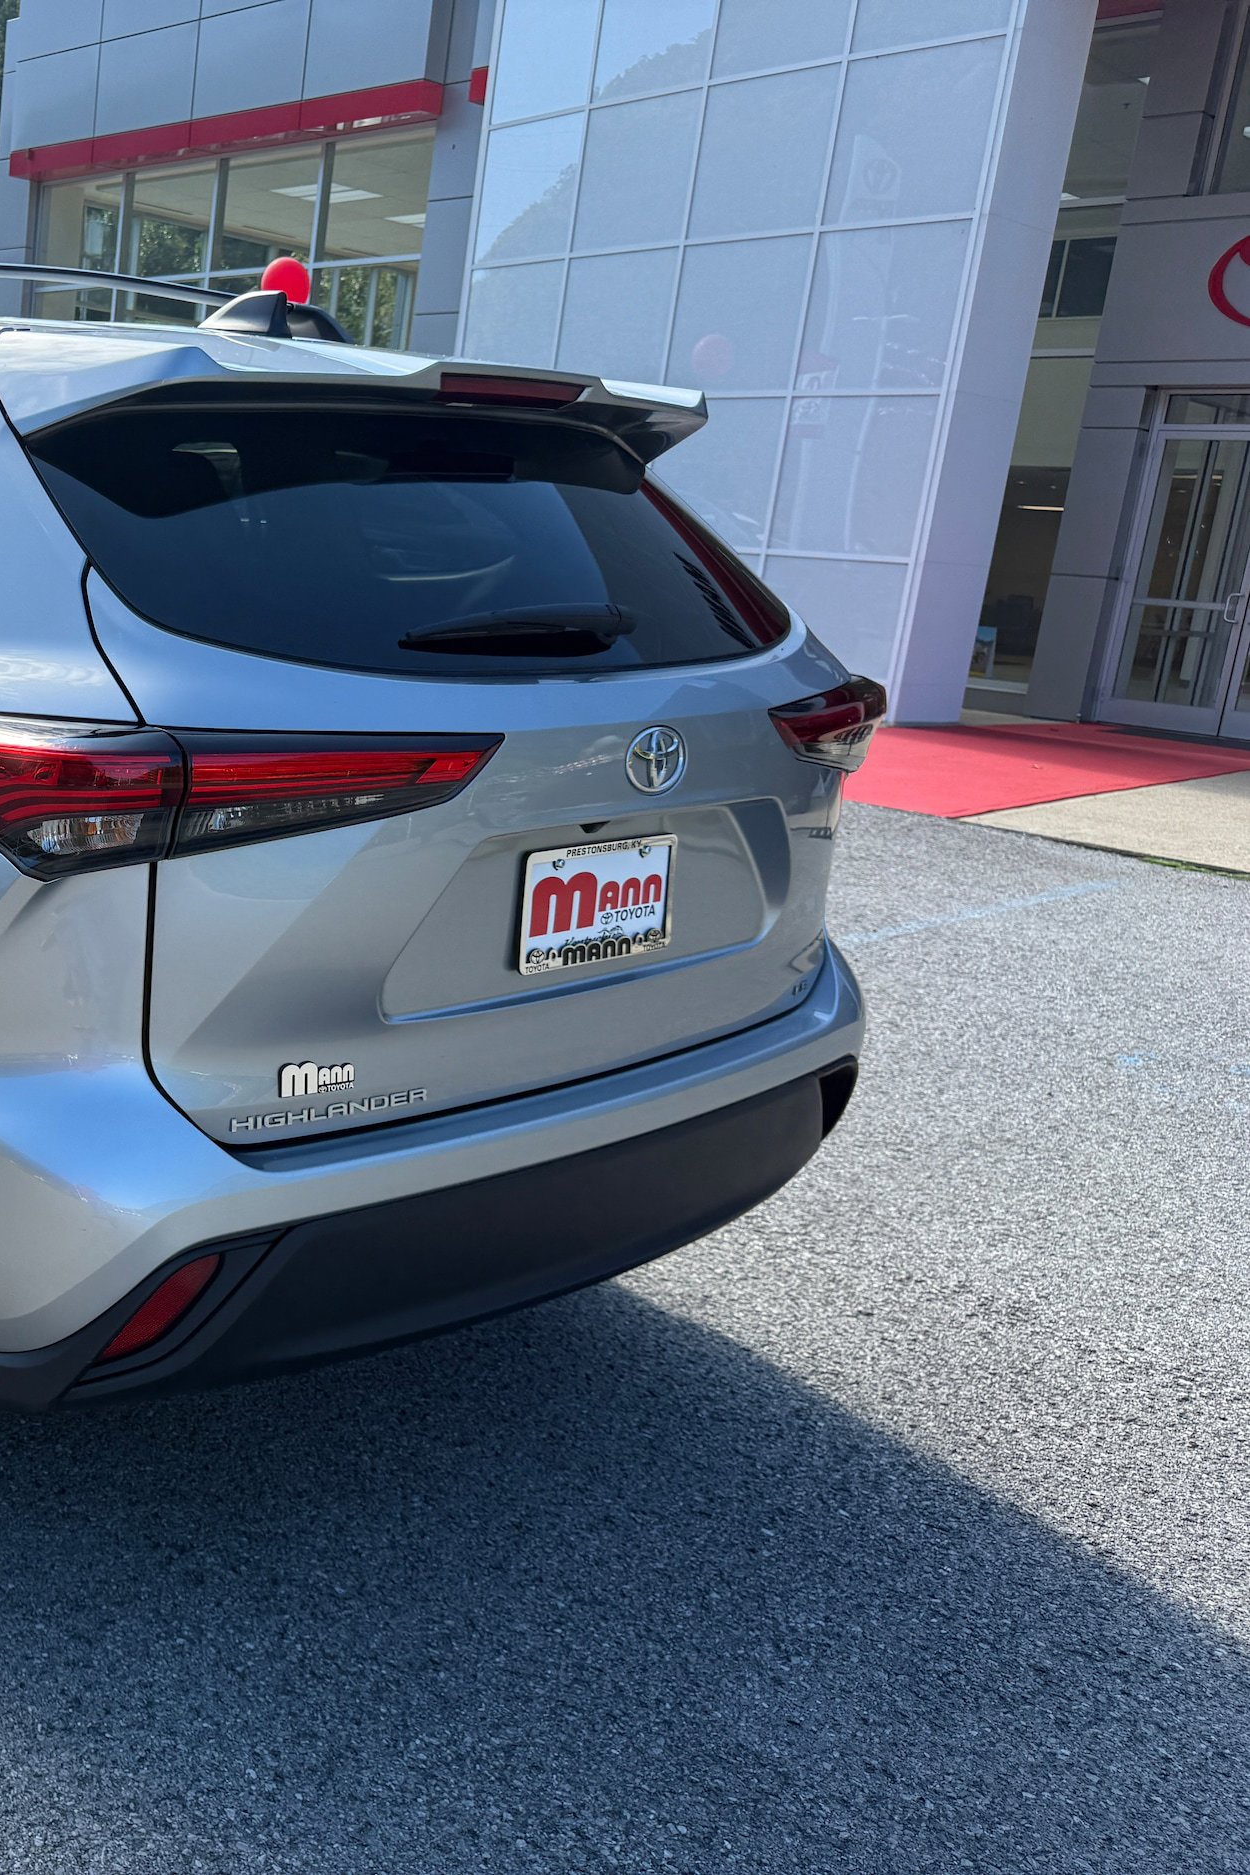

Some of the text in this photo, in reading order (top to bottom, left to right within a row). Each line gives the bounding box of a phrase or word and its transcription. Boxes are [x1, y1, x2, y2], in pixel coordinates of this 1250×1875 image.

[614, 905, 656, 922] TOYOTA
[525, 963, 550, 974] TOYOTA
[327, 1082, 354, 1092] TOYOTA
[230, 1088, 428, 1133] HIGHLANDER
